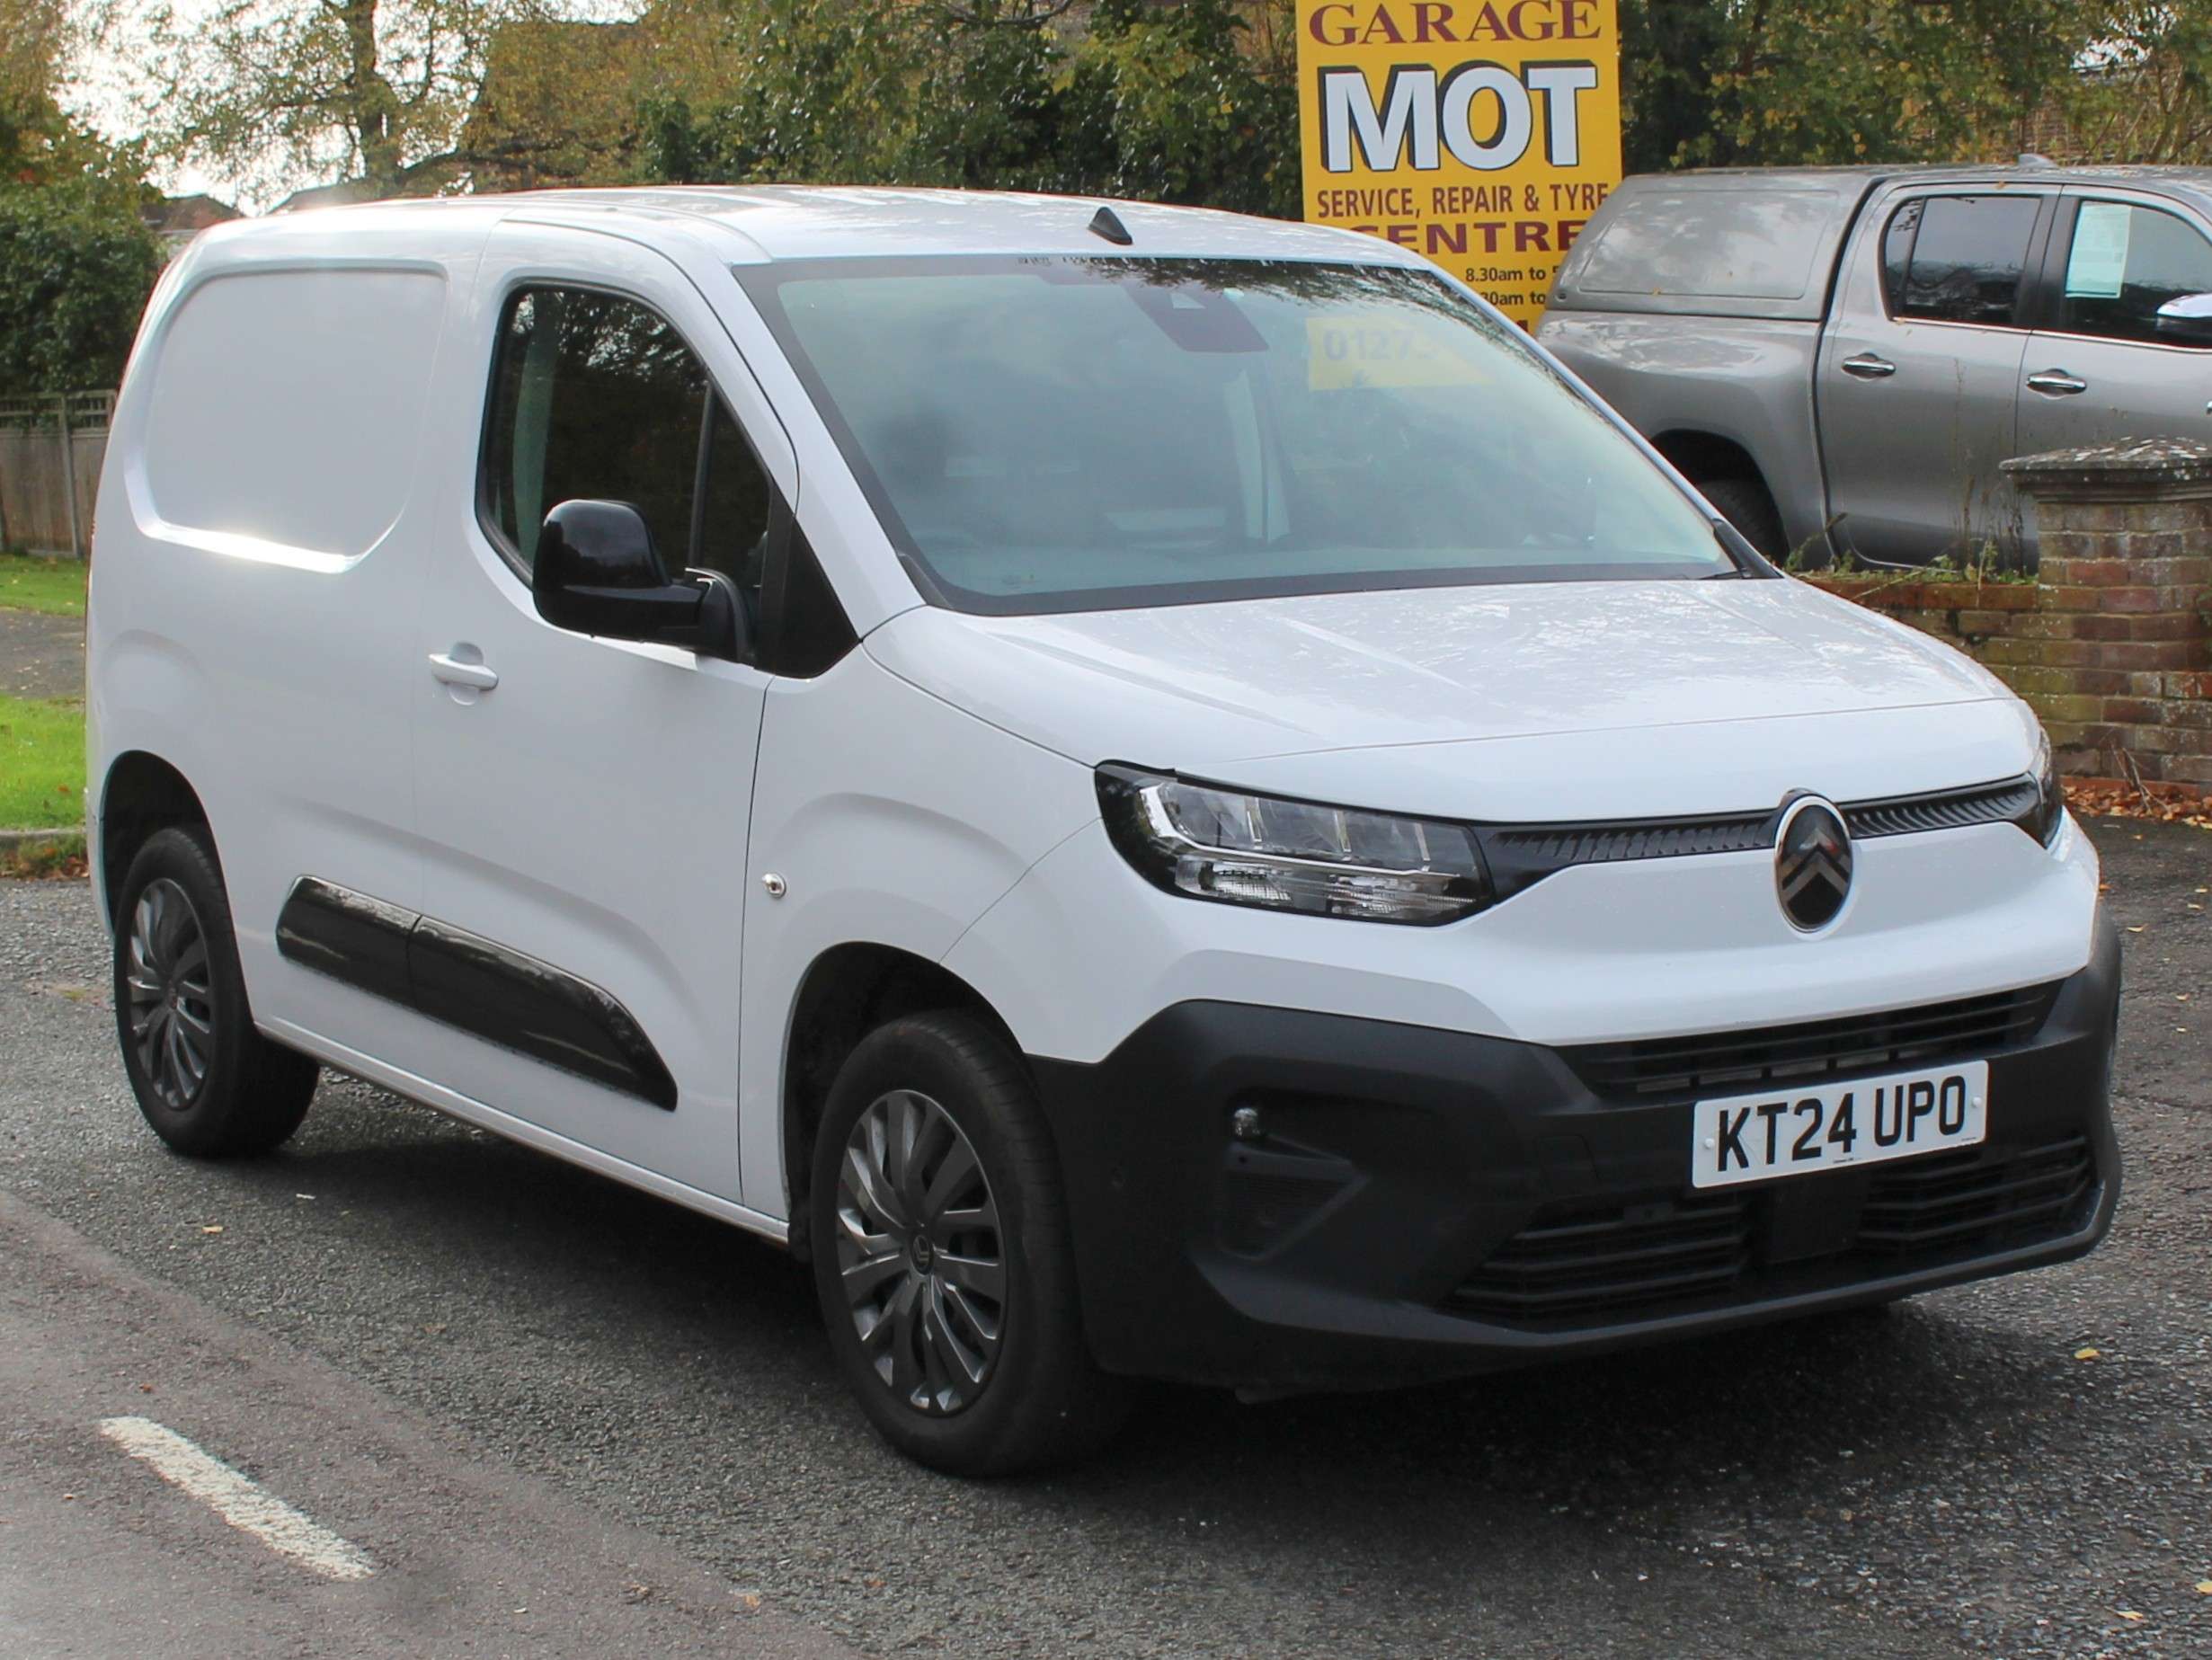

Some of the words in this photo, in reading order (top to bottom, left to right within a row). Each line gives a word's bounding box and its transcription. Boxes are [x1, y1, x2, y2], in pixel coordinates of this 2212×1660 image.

[1309, 0, 1602, 46] GARAGE
[1318, 59, 1598, 173] MOT
[1317, 187, 1420, 218] SERVICE,
[1432, 184, 1513, 214] REPAIR
[1524, 183, 1540, 212] &
[1549, 182, 1609, 210] TYRE
[1465, 267, 1524, 282] 8.30am
[1529, 267, 1546, 280] to
[1530, 291, 1546, 305] to
[1717, 1092, 1858, 1172] KT24
[1874, 1075, 1967, 1148] UPO
